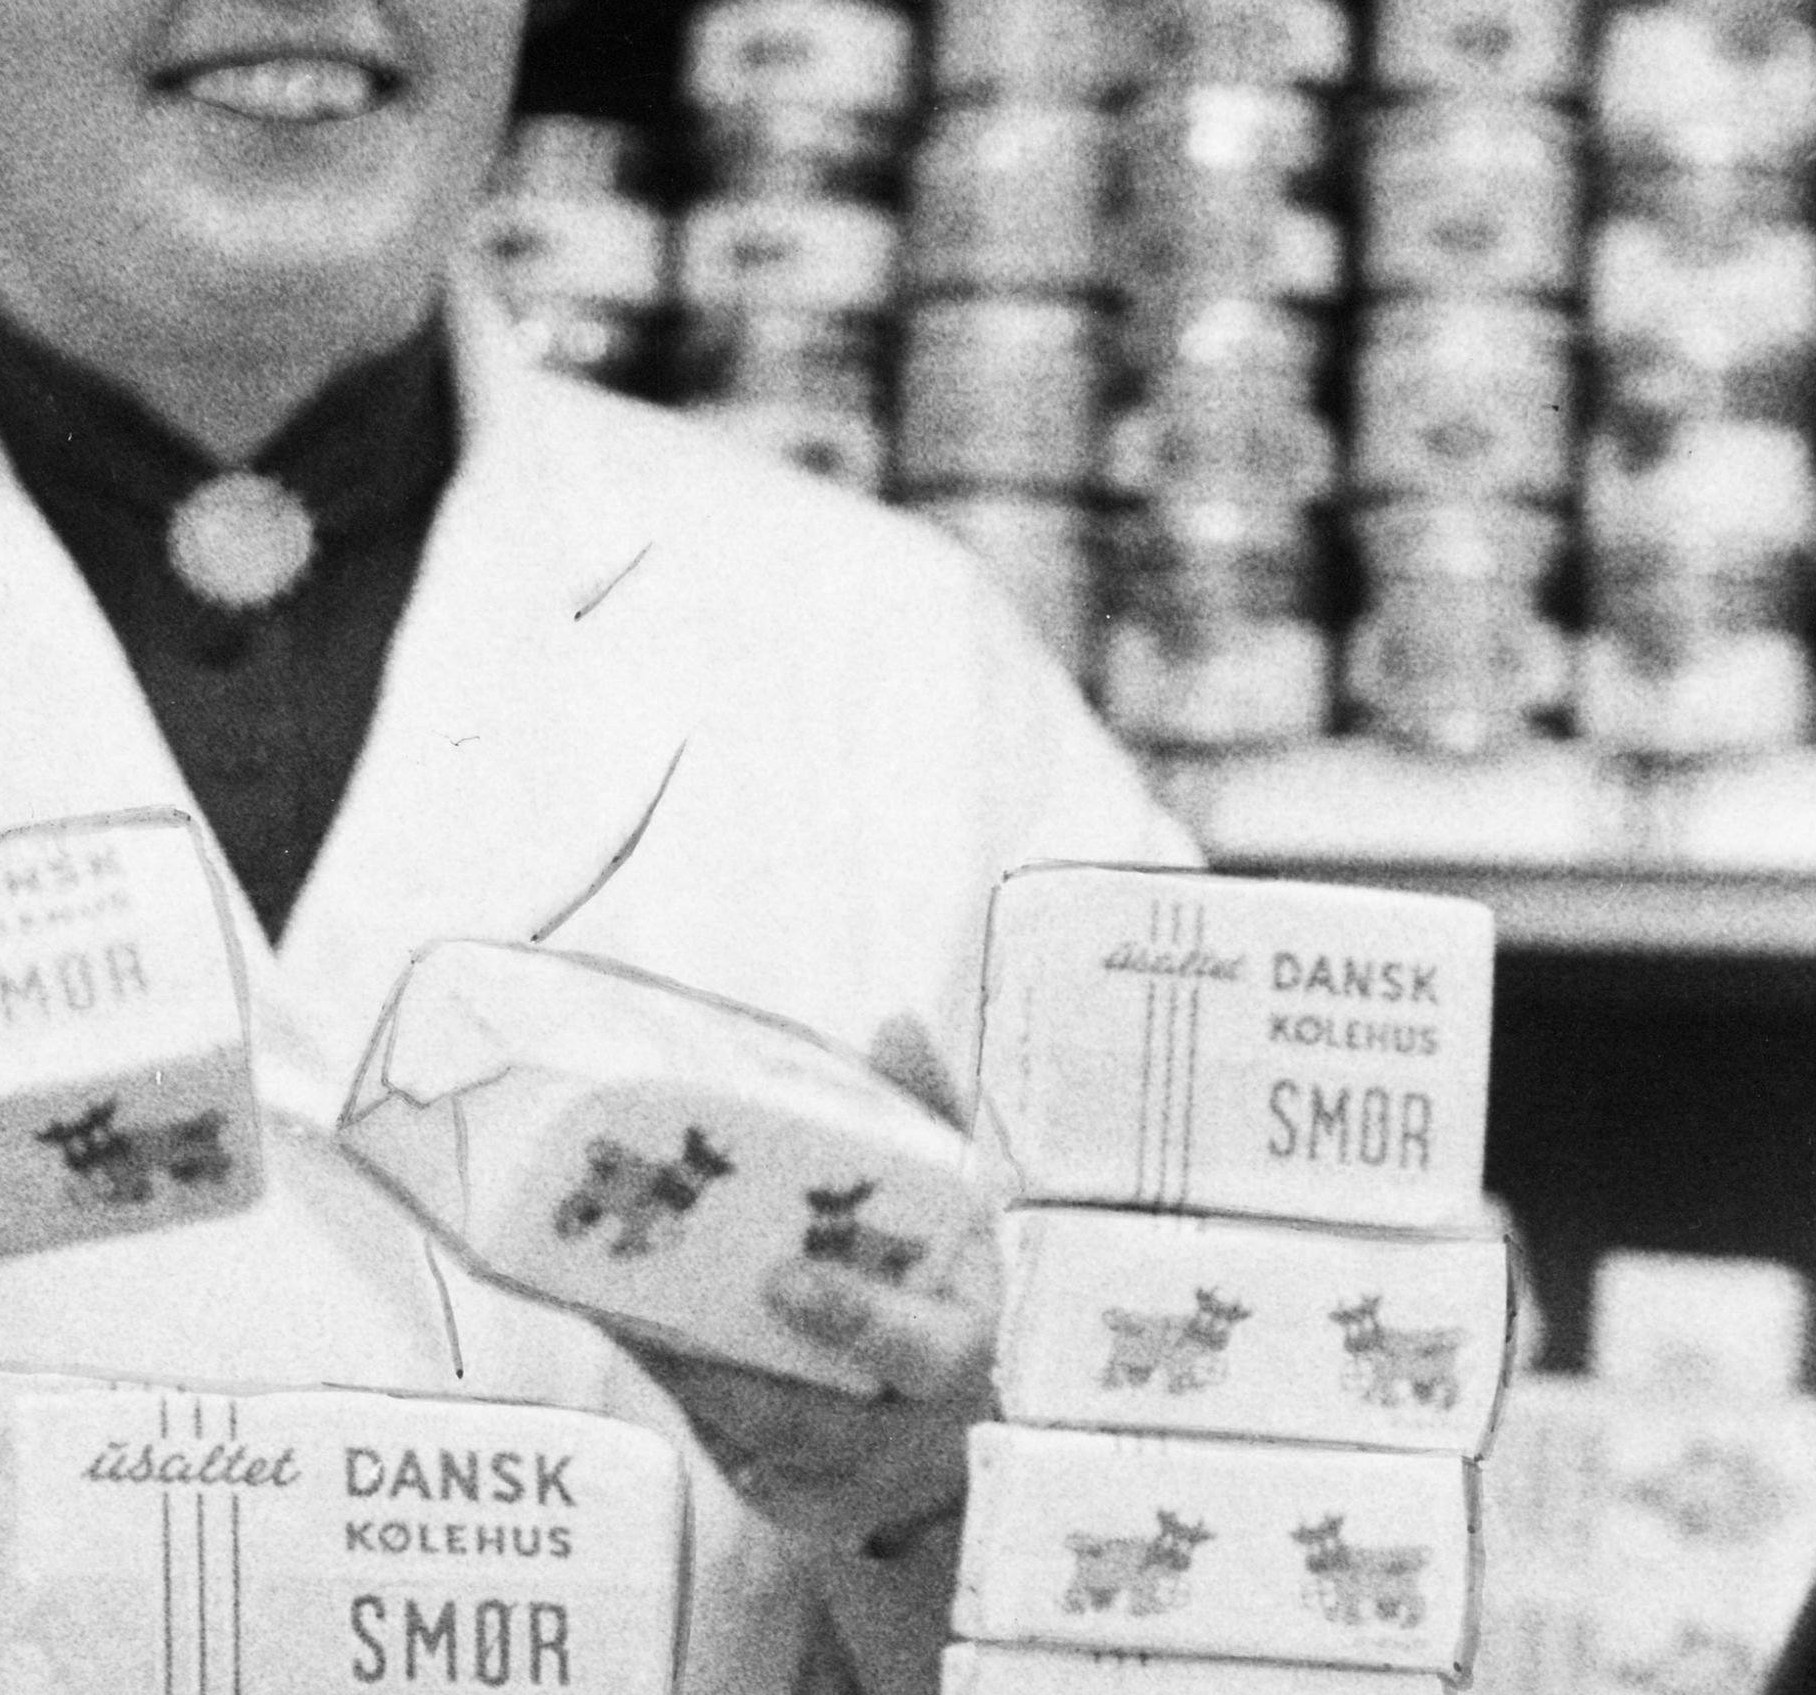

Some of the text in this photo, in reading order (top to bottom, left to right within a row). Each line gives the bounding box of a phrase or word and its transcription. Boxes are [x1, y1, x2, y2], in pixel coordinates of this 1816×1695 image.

[345, 1447, 576, 1508] DANSK
[344, 1520, 573, 1560] KØLEHUS
[350, 1593, 570, 1688] SMØR
